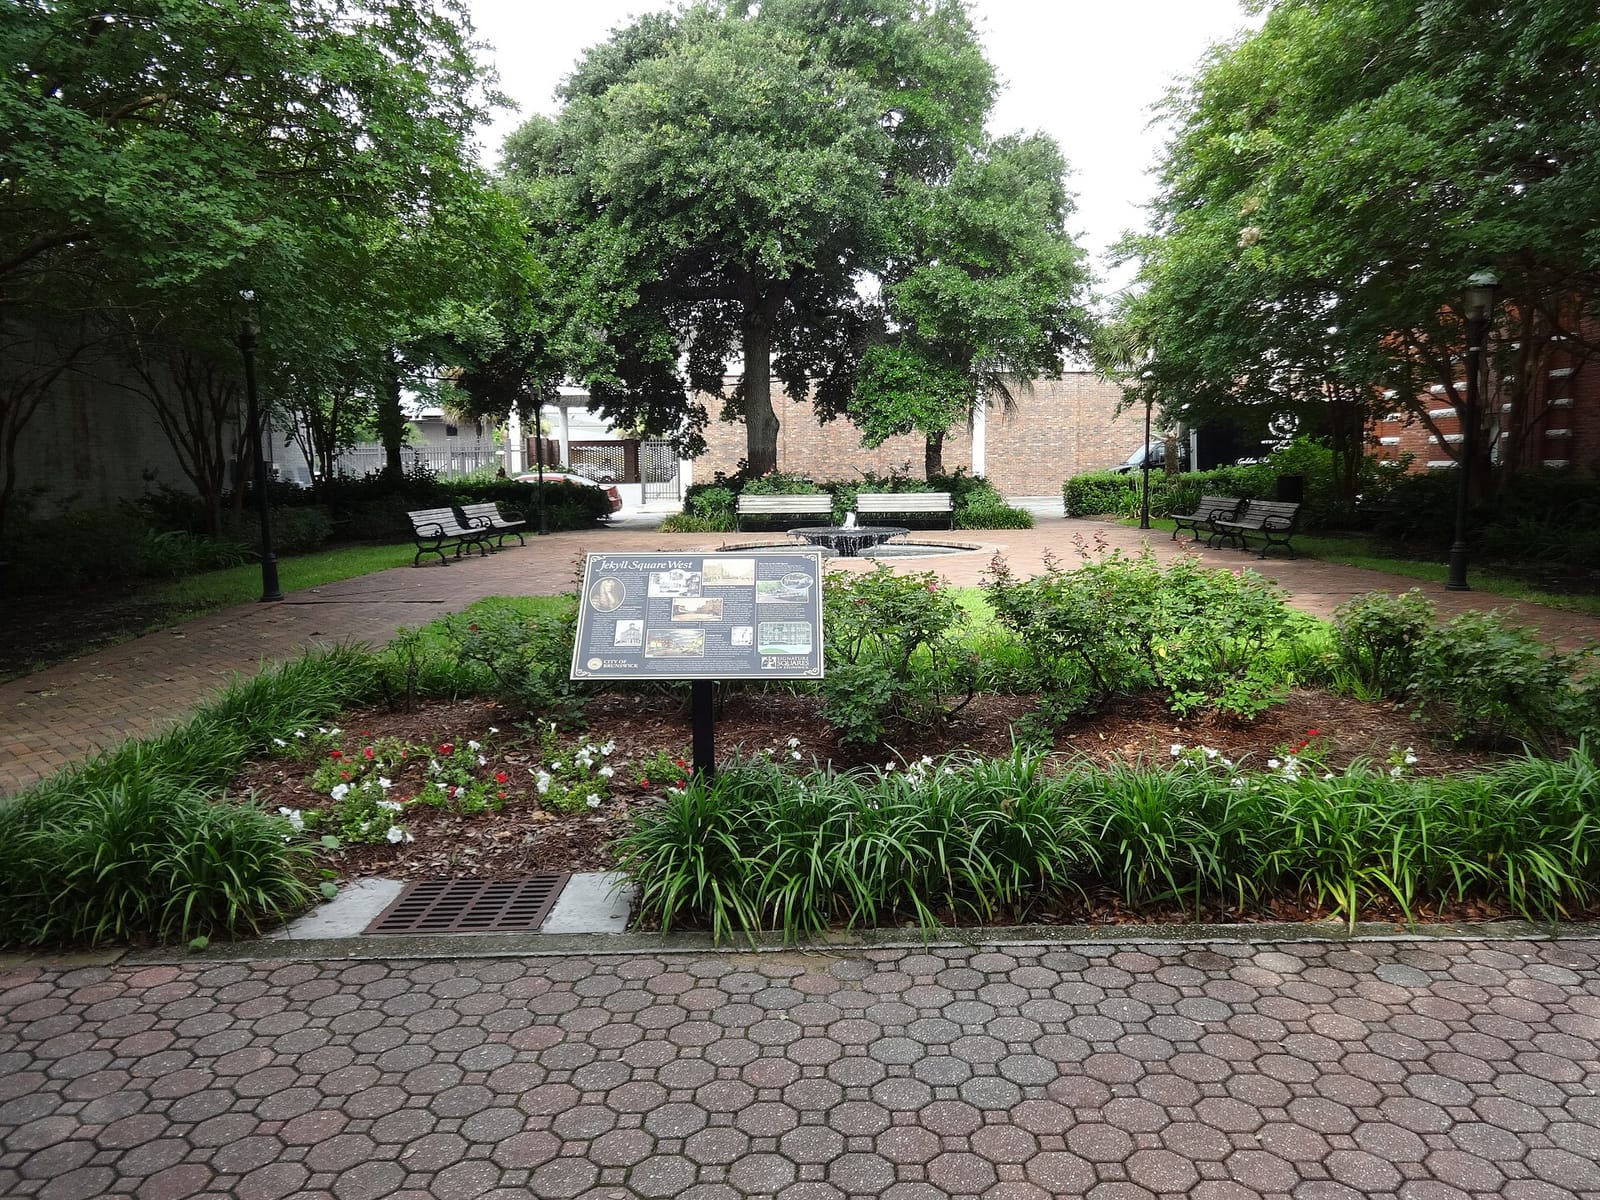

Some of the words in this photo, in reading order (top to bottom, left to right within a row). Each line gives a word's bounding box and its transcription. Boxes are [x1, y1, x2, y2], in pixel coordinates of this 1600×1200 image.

[595, 560, 628, 571] Jekyll
[628, 560, 667, 571] Square
[667, 560, 693, 569] West
